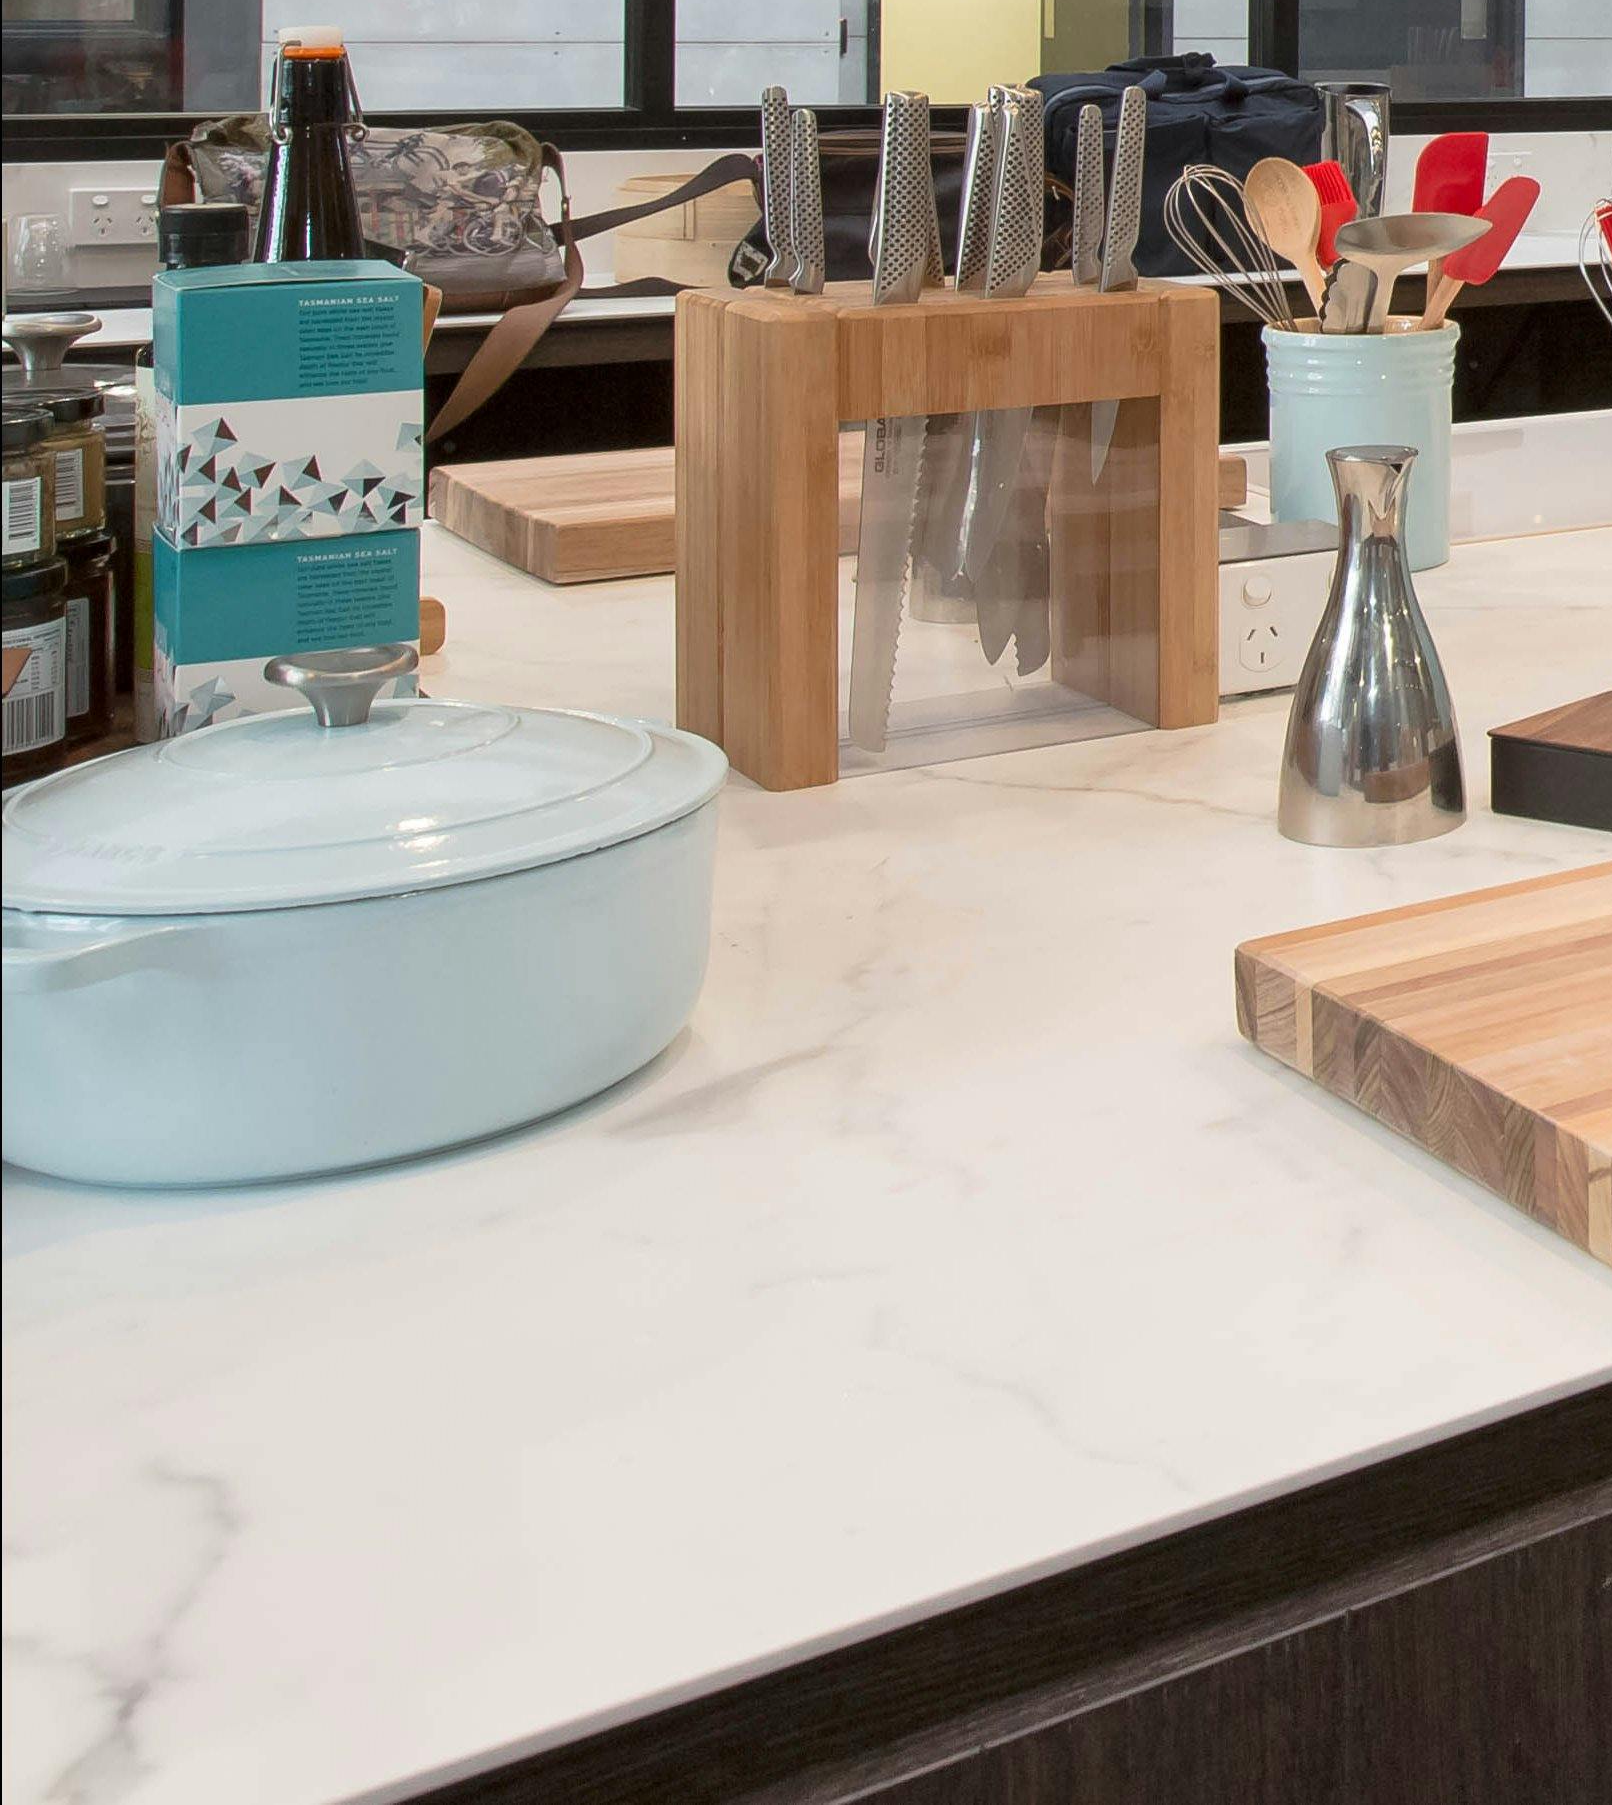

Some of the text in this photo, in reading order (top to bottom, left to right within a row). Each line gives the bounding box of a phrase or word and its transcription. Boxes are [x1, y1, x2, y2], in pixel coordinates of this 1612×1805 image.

[298, 295, 399, 308] TASMANIAN SEA SALT
[874, 418, 886, 472] GLOBA
[297, 548, 398, 563] TASMANIAN SEA SALT
